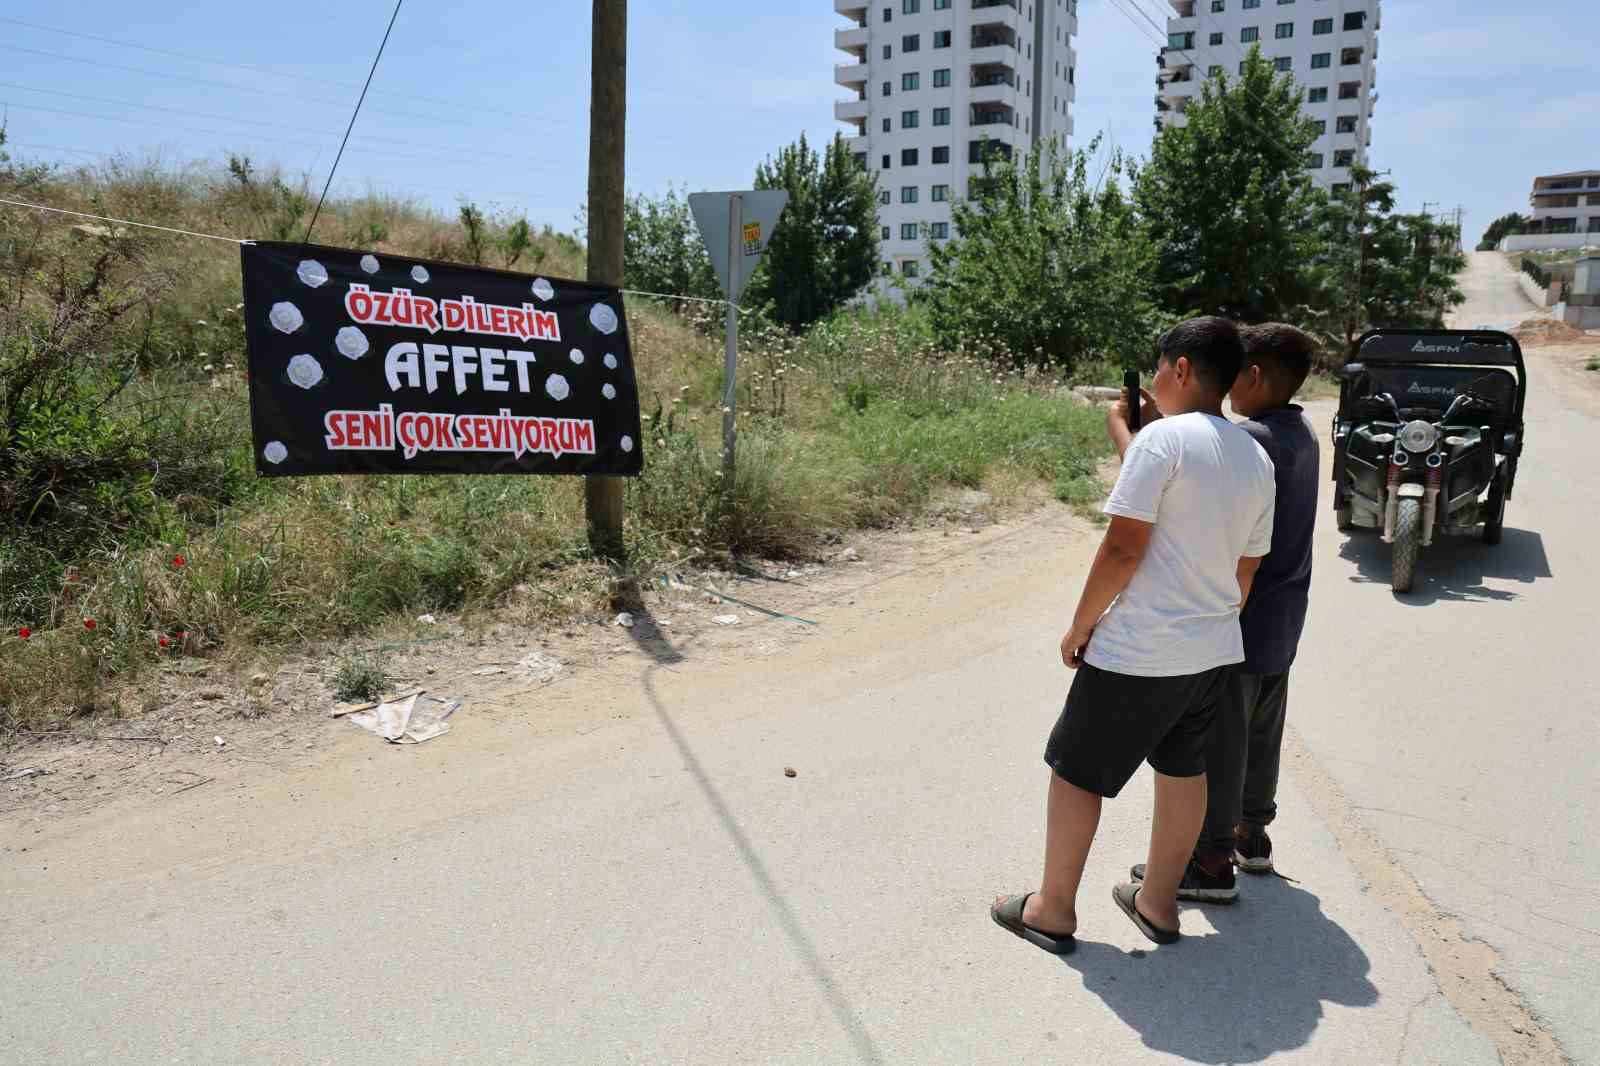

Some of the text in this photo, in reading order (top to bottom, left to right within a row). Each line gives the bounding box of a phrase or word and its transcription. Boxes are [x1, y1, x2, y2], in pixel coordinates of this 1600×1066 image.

[345, 283, 560, 341] ÖZÜR DİLERİM
[385, 342, 536, 395] AFFET
[325, 404, 595, 460] SENİ ÇOK SEVİYORUM
